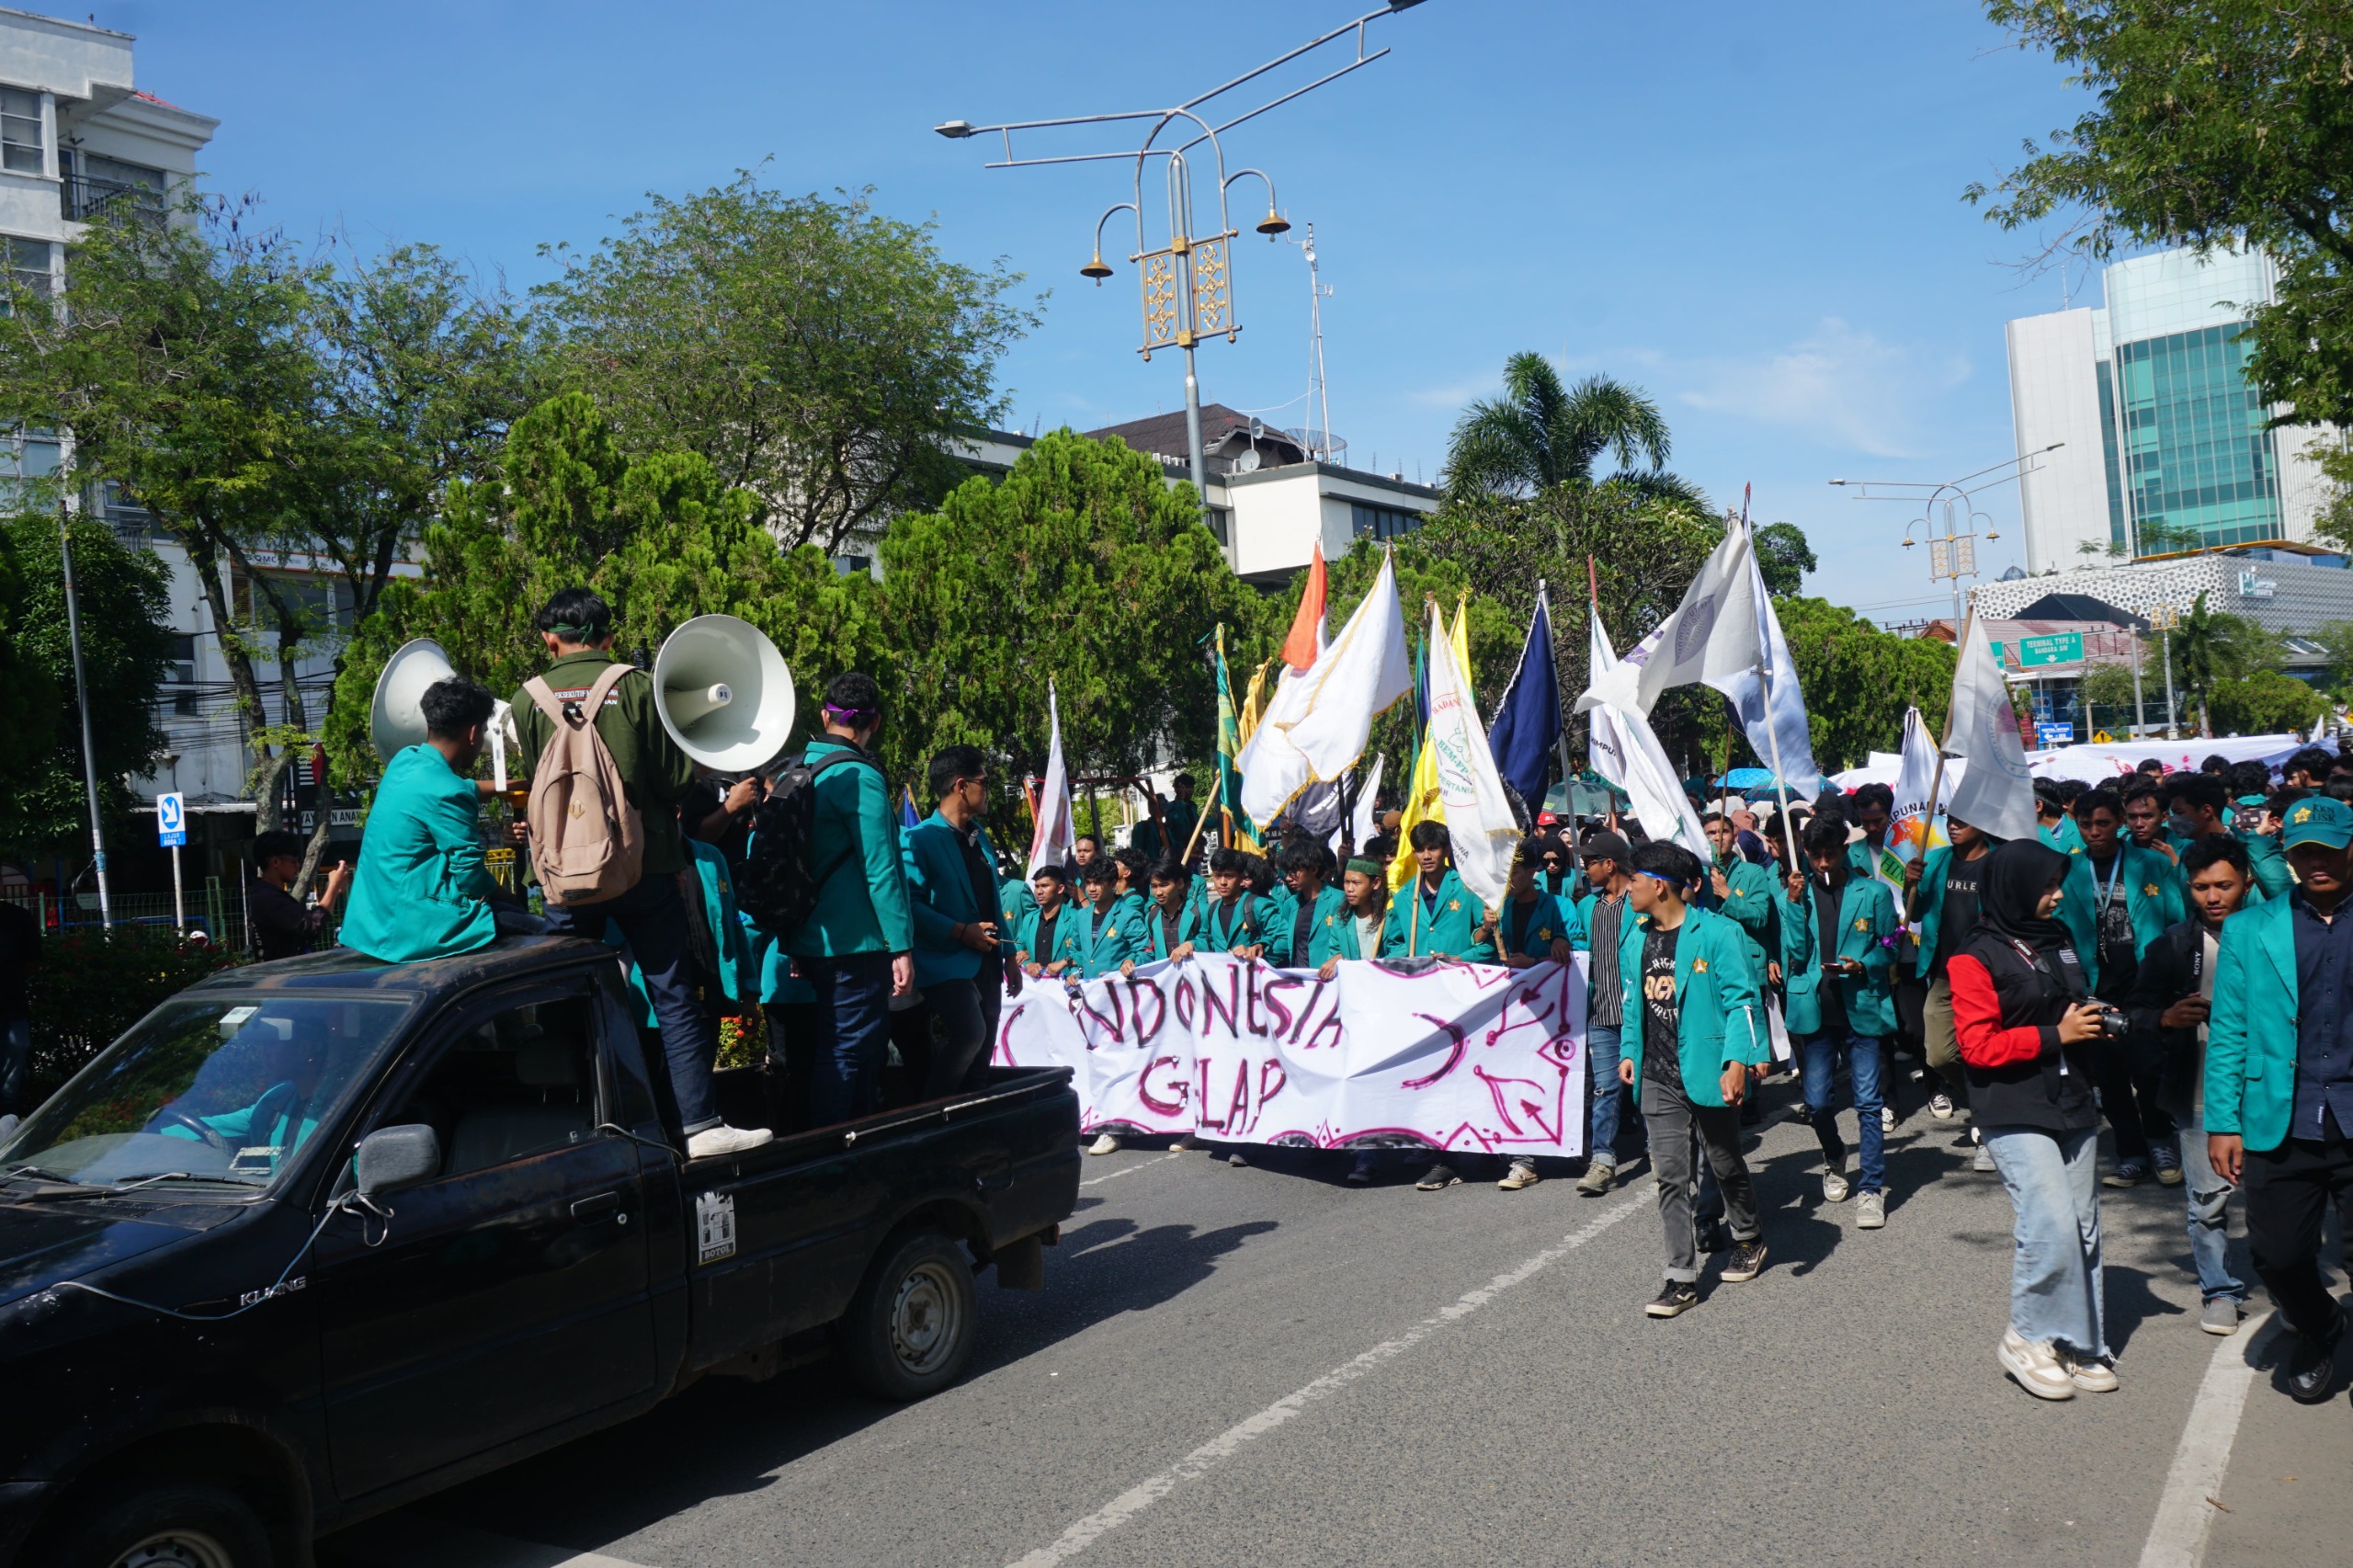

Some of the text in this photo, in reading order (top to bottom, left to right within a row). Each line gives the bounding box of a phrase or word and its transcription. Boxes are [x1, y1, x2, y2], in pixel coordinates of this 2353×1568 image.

[2027, 639, 2053, 648] TERMINAL
[2035, 646, 2058, 654] BANDARA
[1438, 739, 1469, 774] BEM-FP
[1438, 774, 1475, 795] PERTANIA
[2313, 803, 2335, 815] KKN
[2313, 813, 2336, 823] USK
[1947, 880, 1977, 891] URLE
[2193, 951, 2201, 974] SONY
[1069, 961, 1343, 1051] NDONESIA
[1140, 1056, 1287, 1136] GLAP
[704, 1244, 732, 1258] BOTOL
